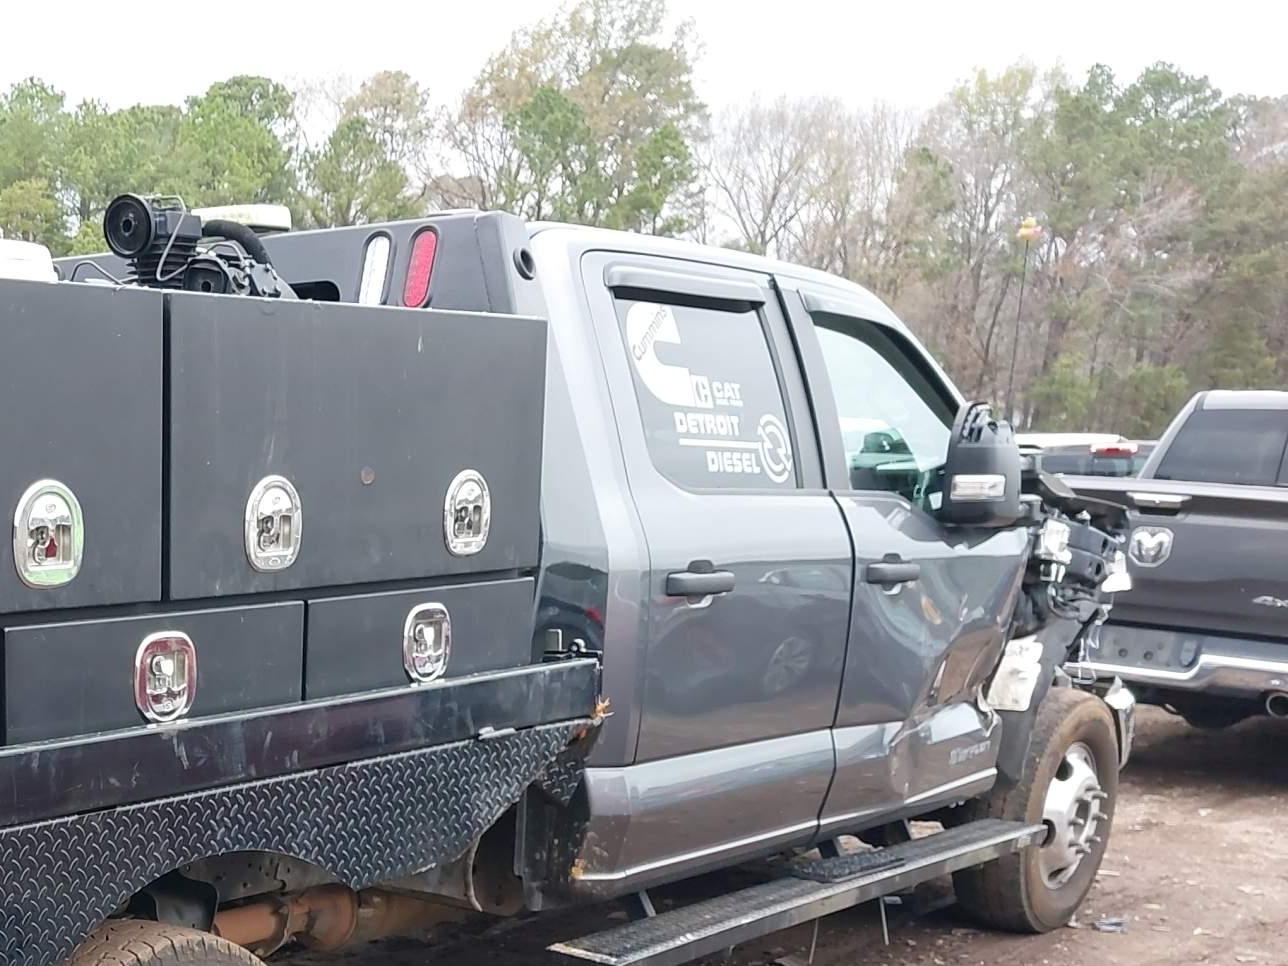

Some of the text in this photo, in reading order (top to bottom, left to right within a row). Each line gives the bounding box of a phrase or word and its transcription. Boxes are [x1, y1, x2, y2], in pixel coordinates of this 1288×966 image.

[632, 304, 668, 361] Cummins
[712, 381, 741, 400] CAT
[673, 412, 741, 436] DETROIT
[706, 450, 761, 475] DIESEL
